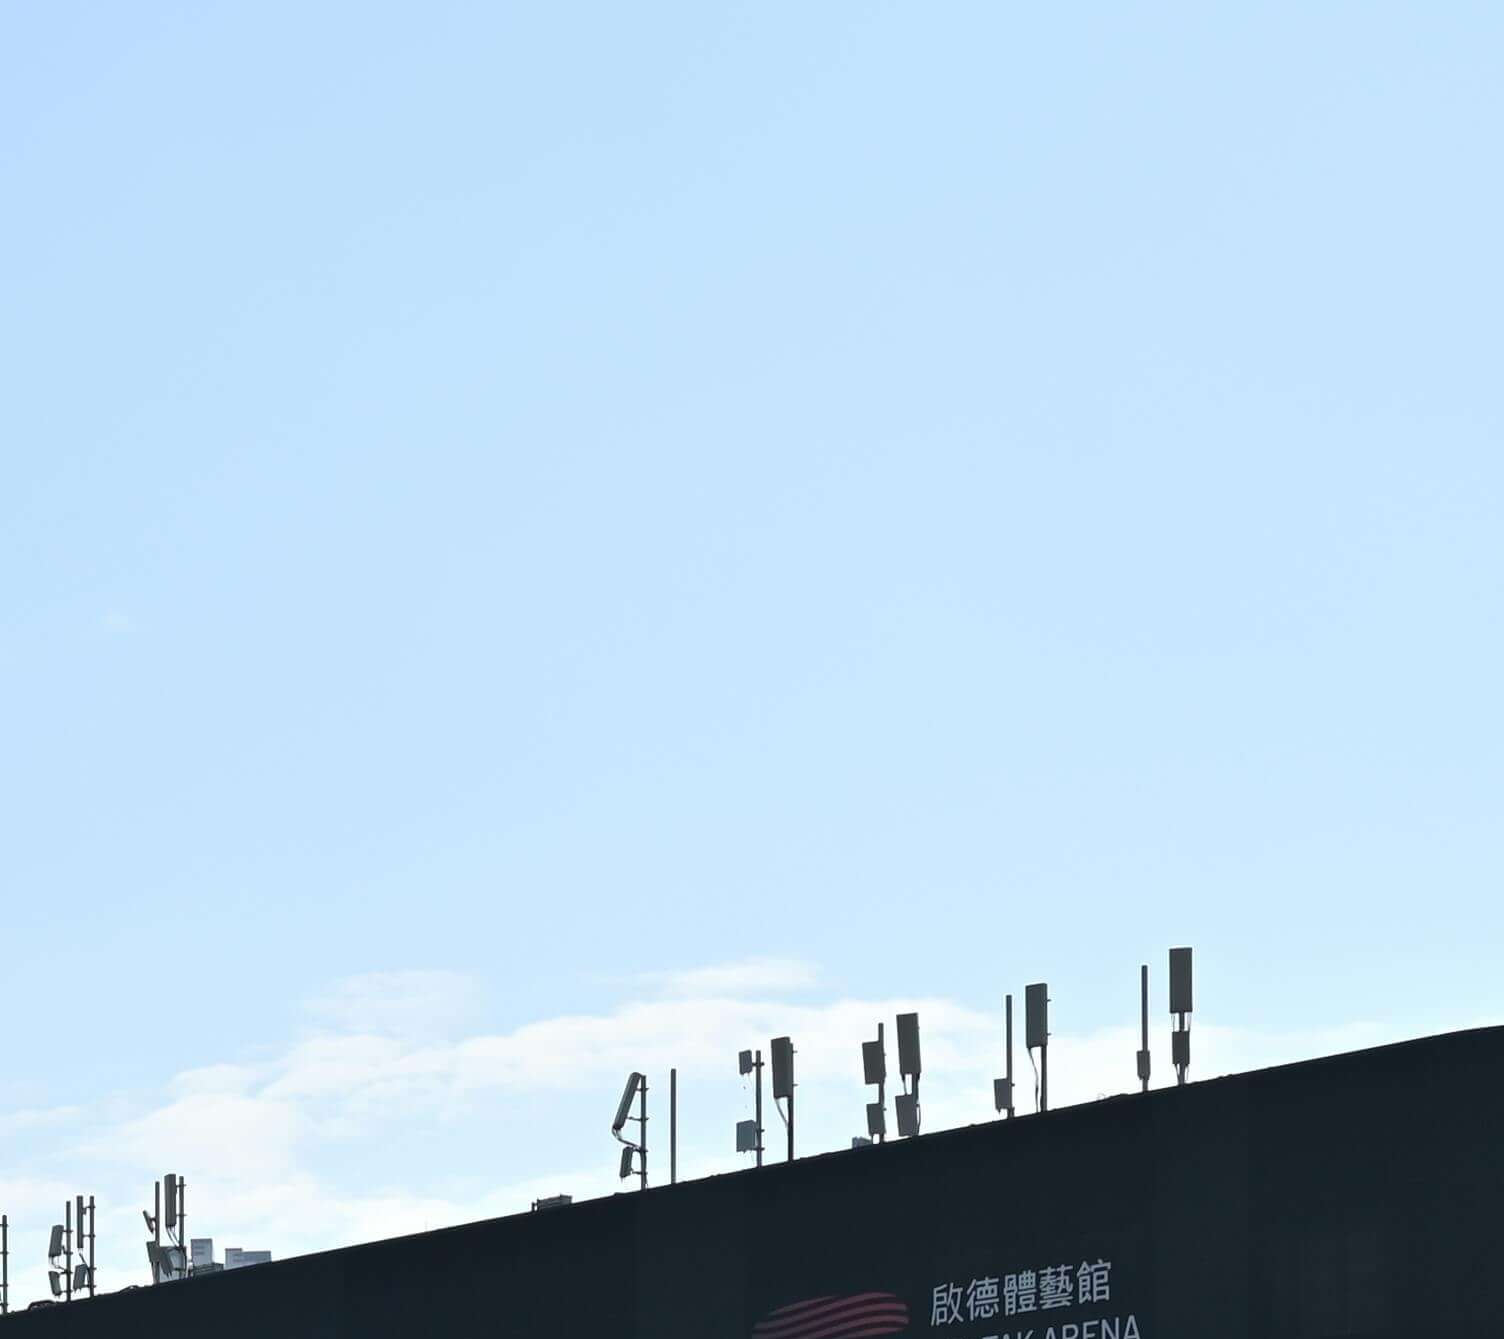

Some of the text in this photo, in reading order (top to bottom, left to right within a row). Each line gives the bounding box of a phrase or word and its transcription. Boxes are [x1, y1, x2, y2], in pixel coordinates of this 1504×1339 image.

[930, 1258, 1112, 1327] 啟德體藝館
